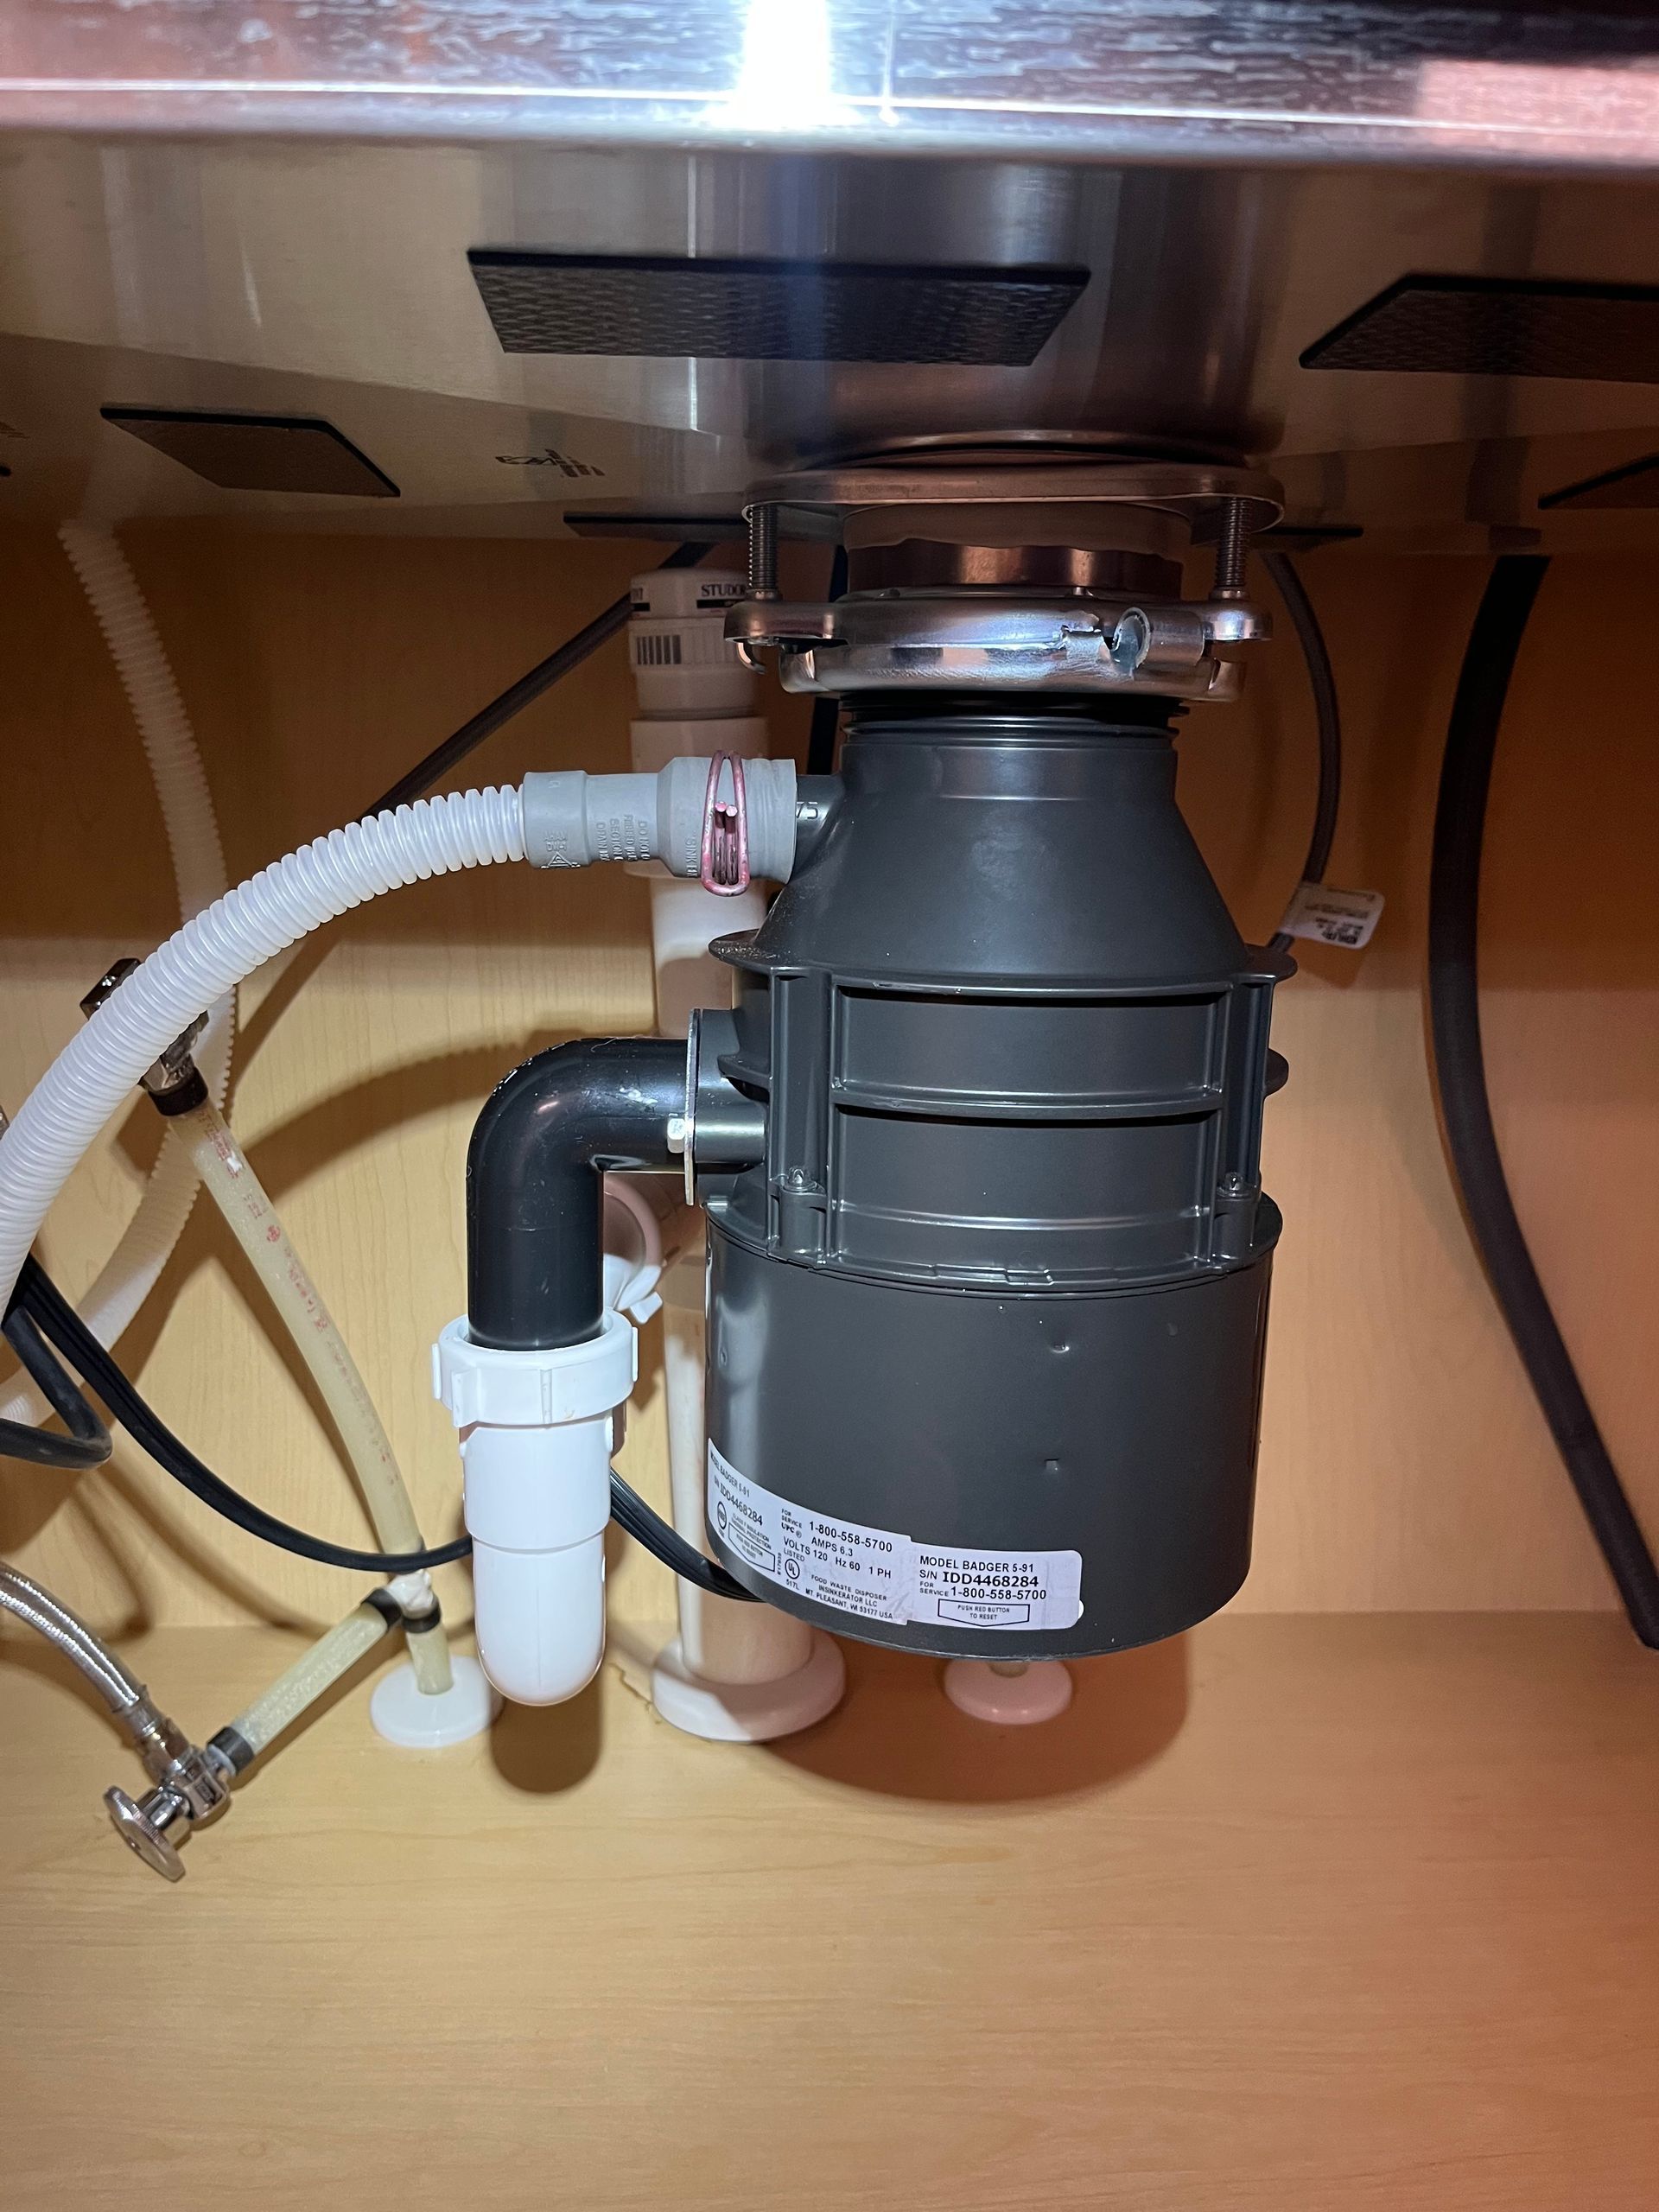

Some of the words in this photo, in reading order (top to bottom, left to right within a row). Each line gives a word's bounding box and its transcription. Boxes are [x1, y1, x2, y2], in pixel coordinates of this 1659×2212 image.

[720, 1465, 738, 1489] BADGER
[720, 1483, 763, 1526] IDD4468284
[781, 1509, 792, 1517] FOR
[781, 1515, 803, 1529] SERVICE
[809, 1521, 893, 1553] 1-800-558-5700
[781, 1522, 795, 1534] UPC
[811, 1536, 837, 1553] AMPS
[840, 1546, 854, 1557] 6.3
[783, 1535, 810, 1555] VOLTS
[813, 1549, 828, 1561] 120
[836, 1556, 847, 1568] Hz
[849, 1560, 861, 1571] 60
[868, 1566, 874, 1575] 1
[877, 1567, 892, 1579] PH
[784, 1548, 805, 1562] LISTED
[919, 1554, 959, 1569] MODEL
[962, 1560, 1009, 1573] BADGER
[1012, 1562, 1034, 1573] 5-91
[811, 1574, 828, 1585] FOOD
[830, 1581, 852, 1592] WASTE
[855, 1588, 887, 1601] DISPOSER
[919, 1569, 938, 1580] S/N
[943, 1571, 1039, 1588] IDD4468284
[818, 1585, 863, 1603] INSINKERATOR
[865, 1599, 878, 1608] LLC
[919, 1587, 949, 1597] SERVICE
[950, 1586, 1047, 1600] 1-800-558-5700
[860, 1605, 878, 1616] 53177
[879, 1611, 893, 1619] USA
